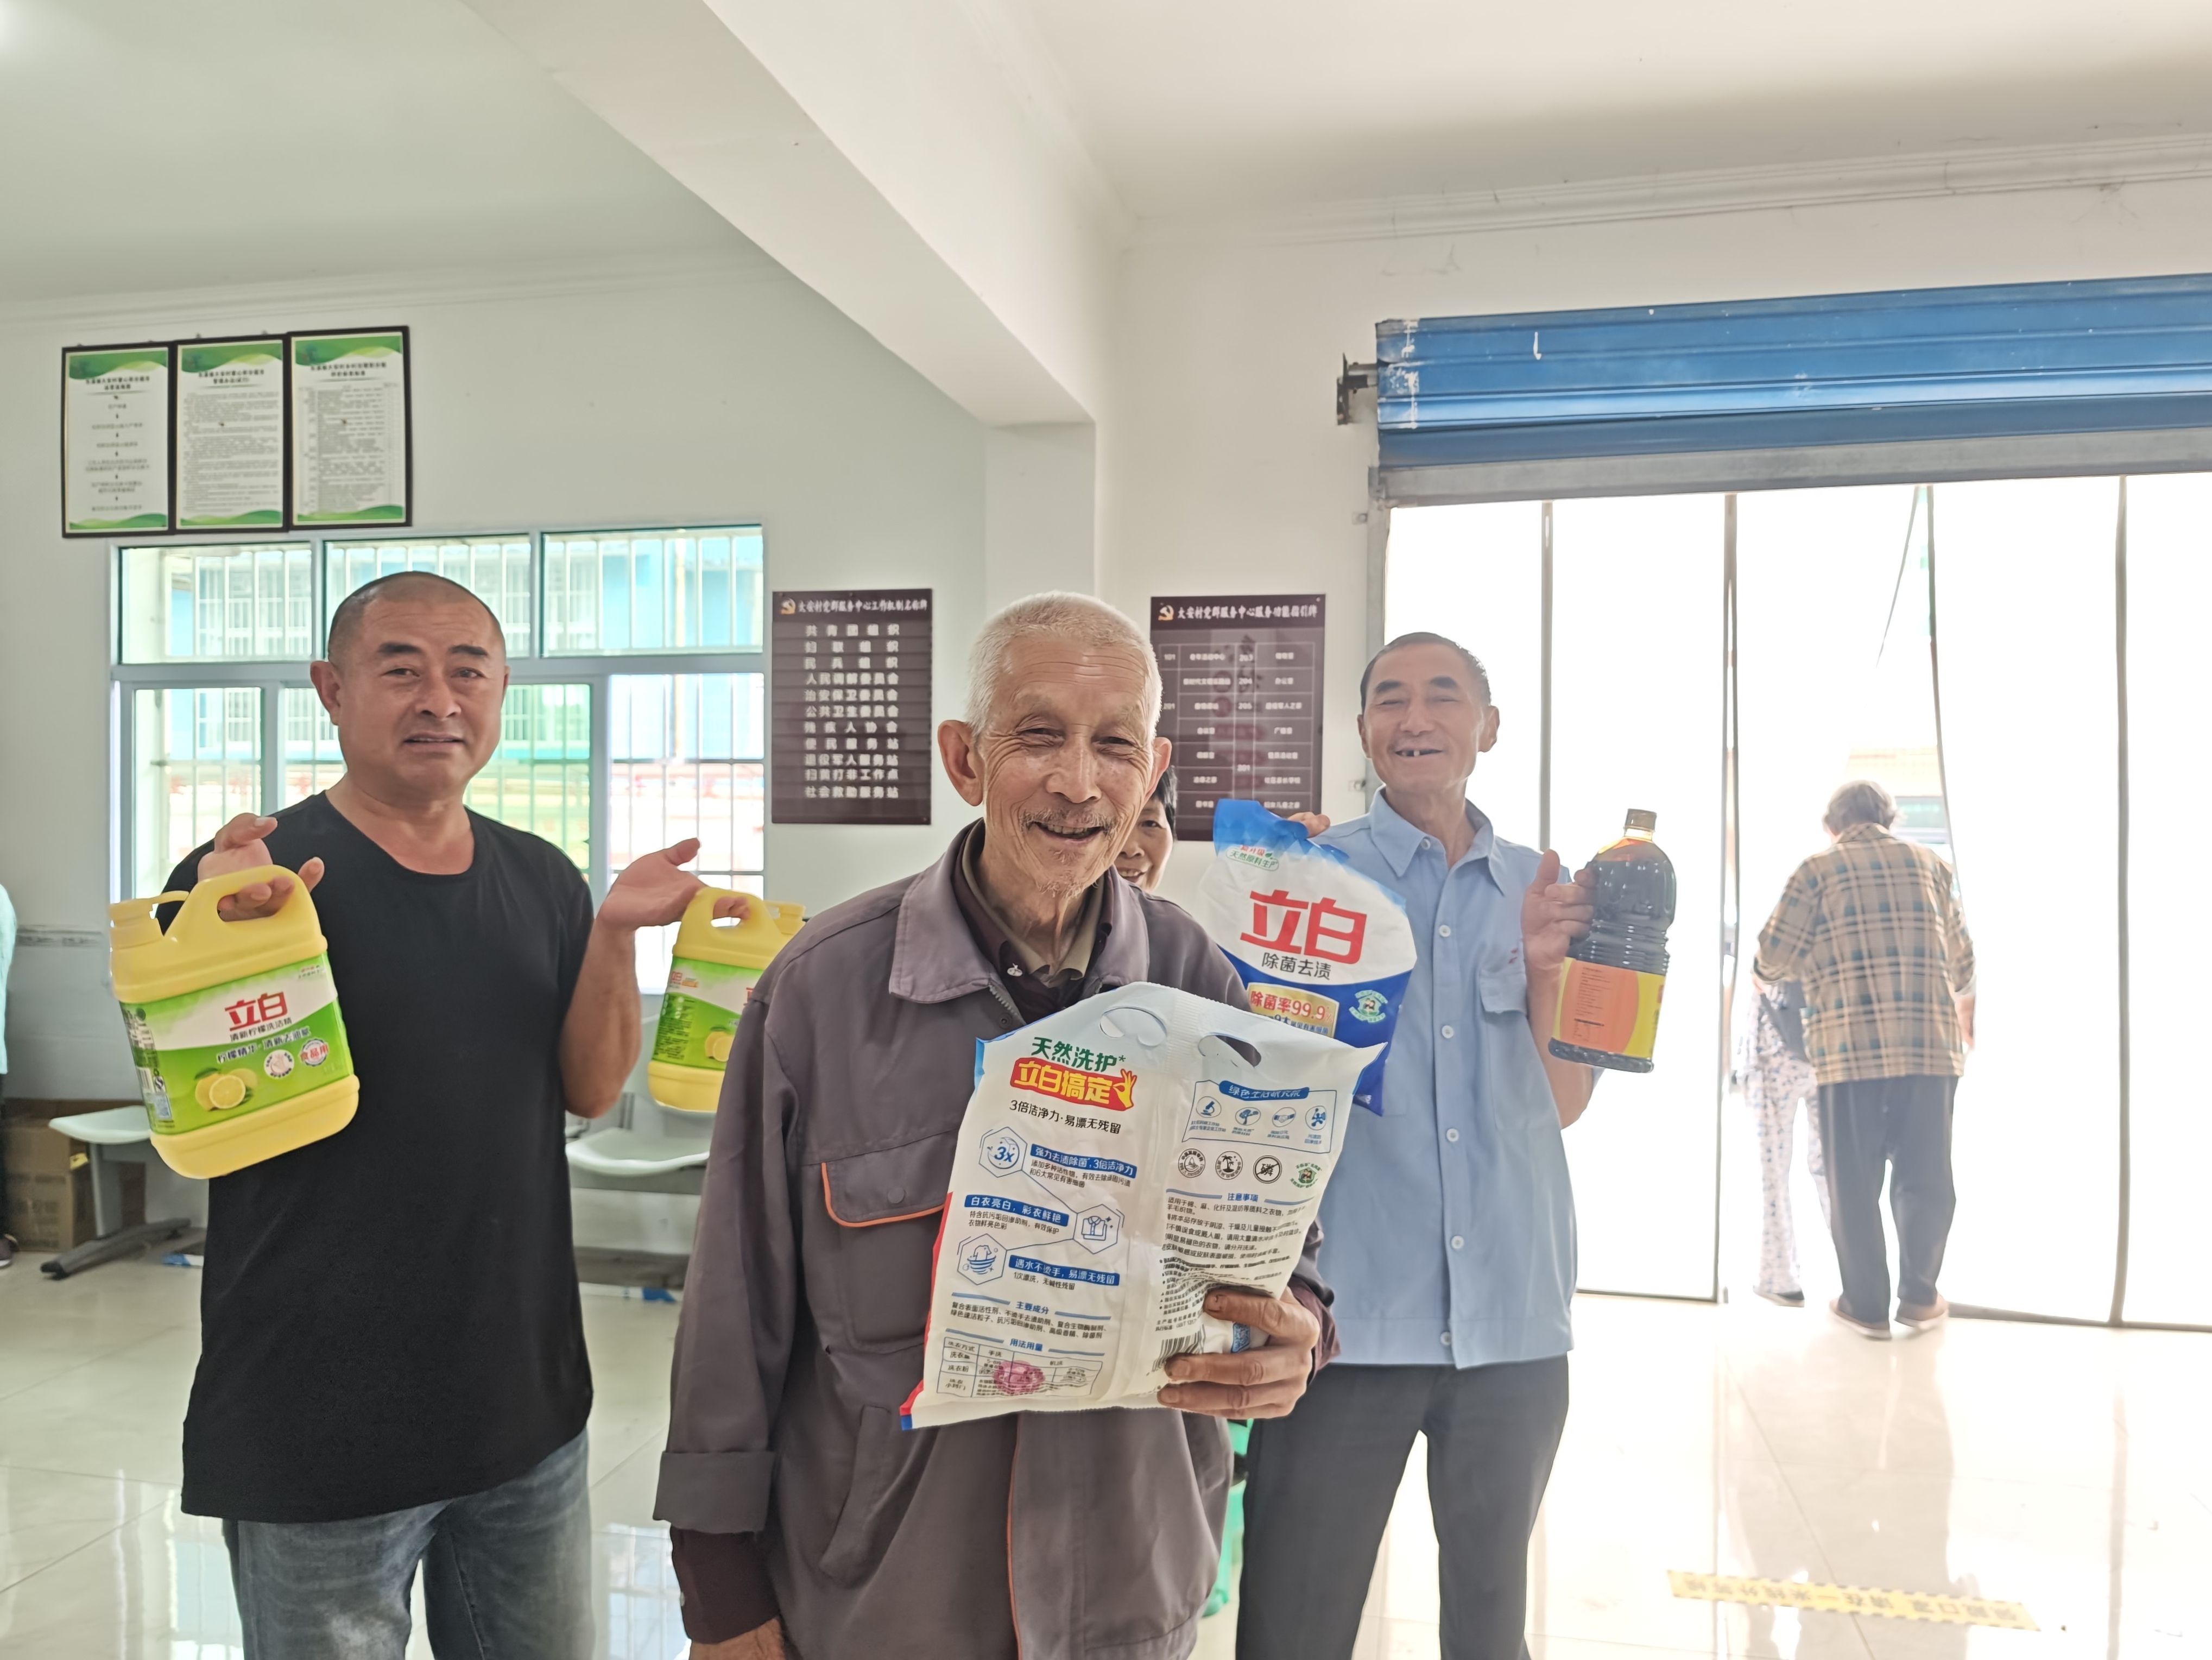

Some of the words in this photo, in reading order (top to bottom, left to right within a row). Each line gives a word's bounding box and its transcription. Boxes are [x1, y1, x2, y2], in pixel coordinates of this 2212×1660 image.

[1240, 889, 1368, 964] 立白
[1261, 952, 1332, 981] 除菌去渍
[225, 992, 288, 1031] 立白
[230, 1017, 292, 1042] 清新柠檬洗洁精
[1014, 1061, 1113, 1104] 立白搞定
[1227, 1192, 1259, 1202] 注意事项
[968, 1220, 1007, 1230] 衣物鲜亮色彩
[1016, 1301, 1049, 1314] 主要成分
[1010, 1339, 1043, 1352] 用法用量
[948, 1365, 969, 1373] 洗衣粉
